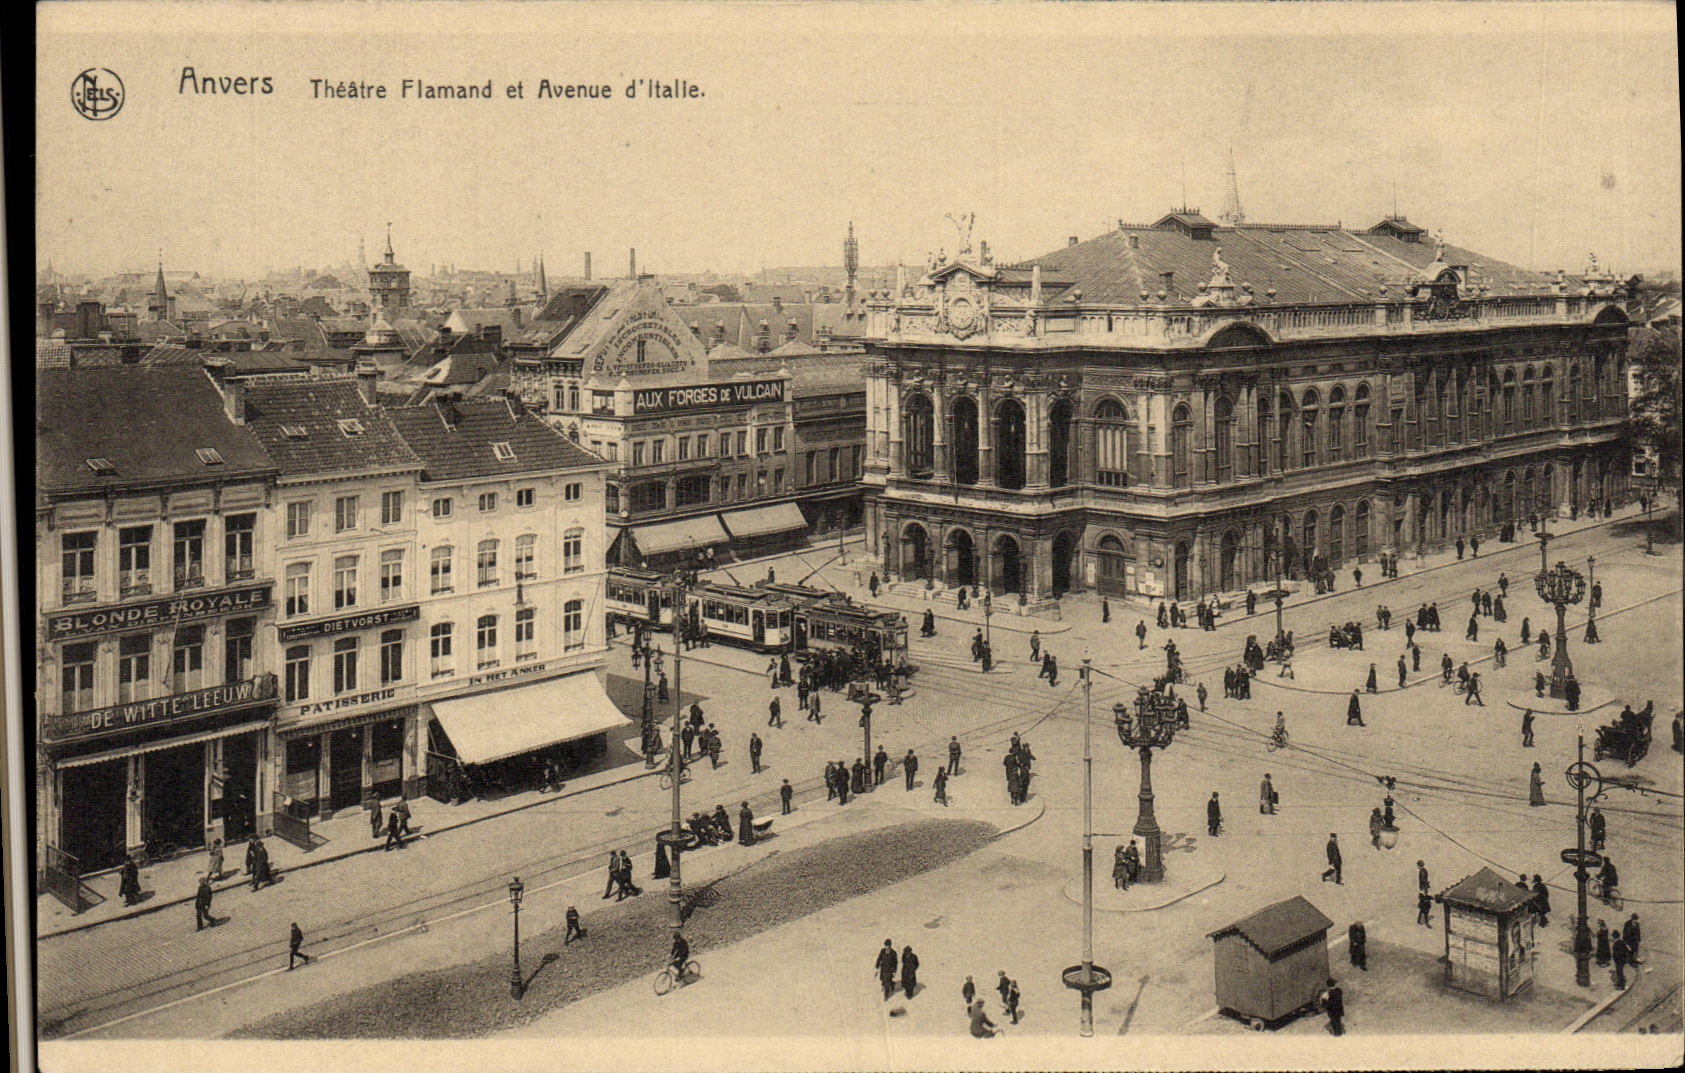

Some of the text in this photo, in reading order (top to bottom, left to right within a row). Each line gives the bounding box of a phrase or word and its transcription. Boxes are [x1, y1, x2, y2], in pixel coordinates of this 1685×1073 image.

[635, 392, 664, 410] AUX
[668, 387, 718, 407] FORGES
[734, 382, 782, 401] VULCAIN
[53, 590, 263, 632] BLONDE ROYALE
[324, 613, 390, 632] DIETVORST
[486, 671, 507, 681] HET
[510, 664, 546, 677] ANKER
[91, 684, 250, 729] DE WITTE LEEUW
[299, 688, 395, 716] PATISSERIE
